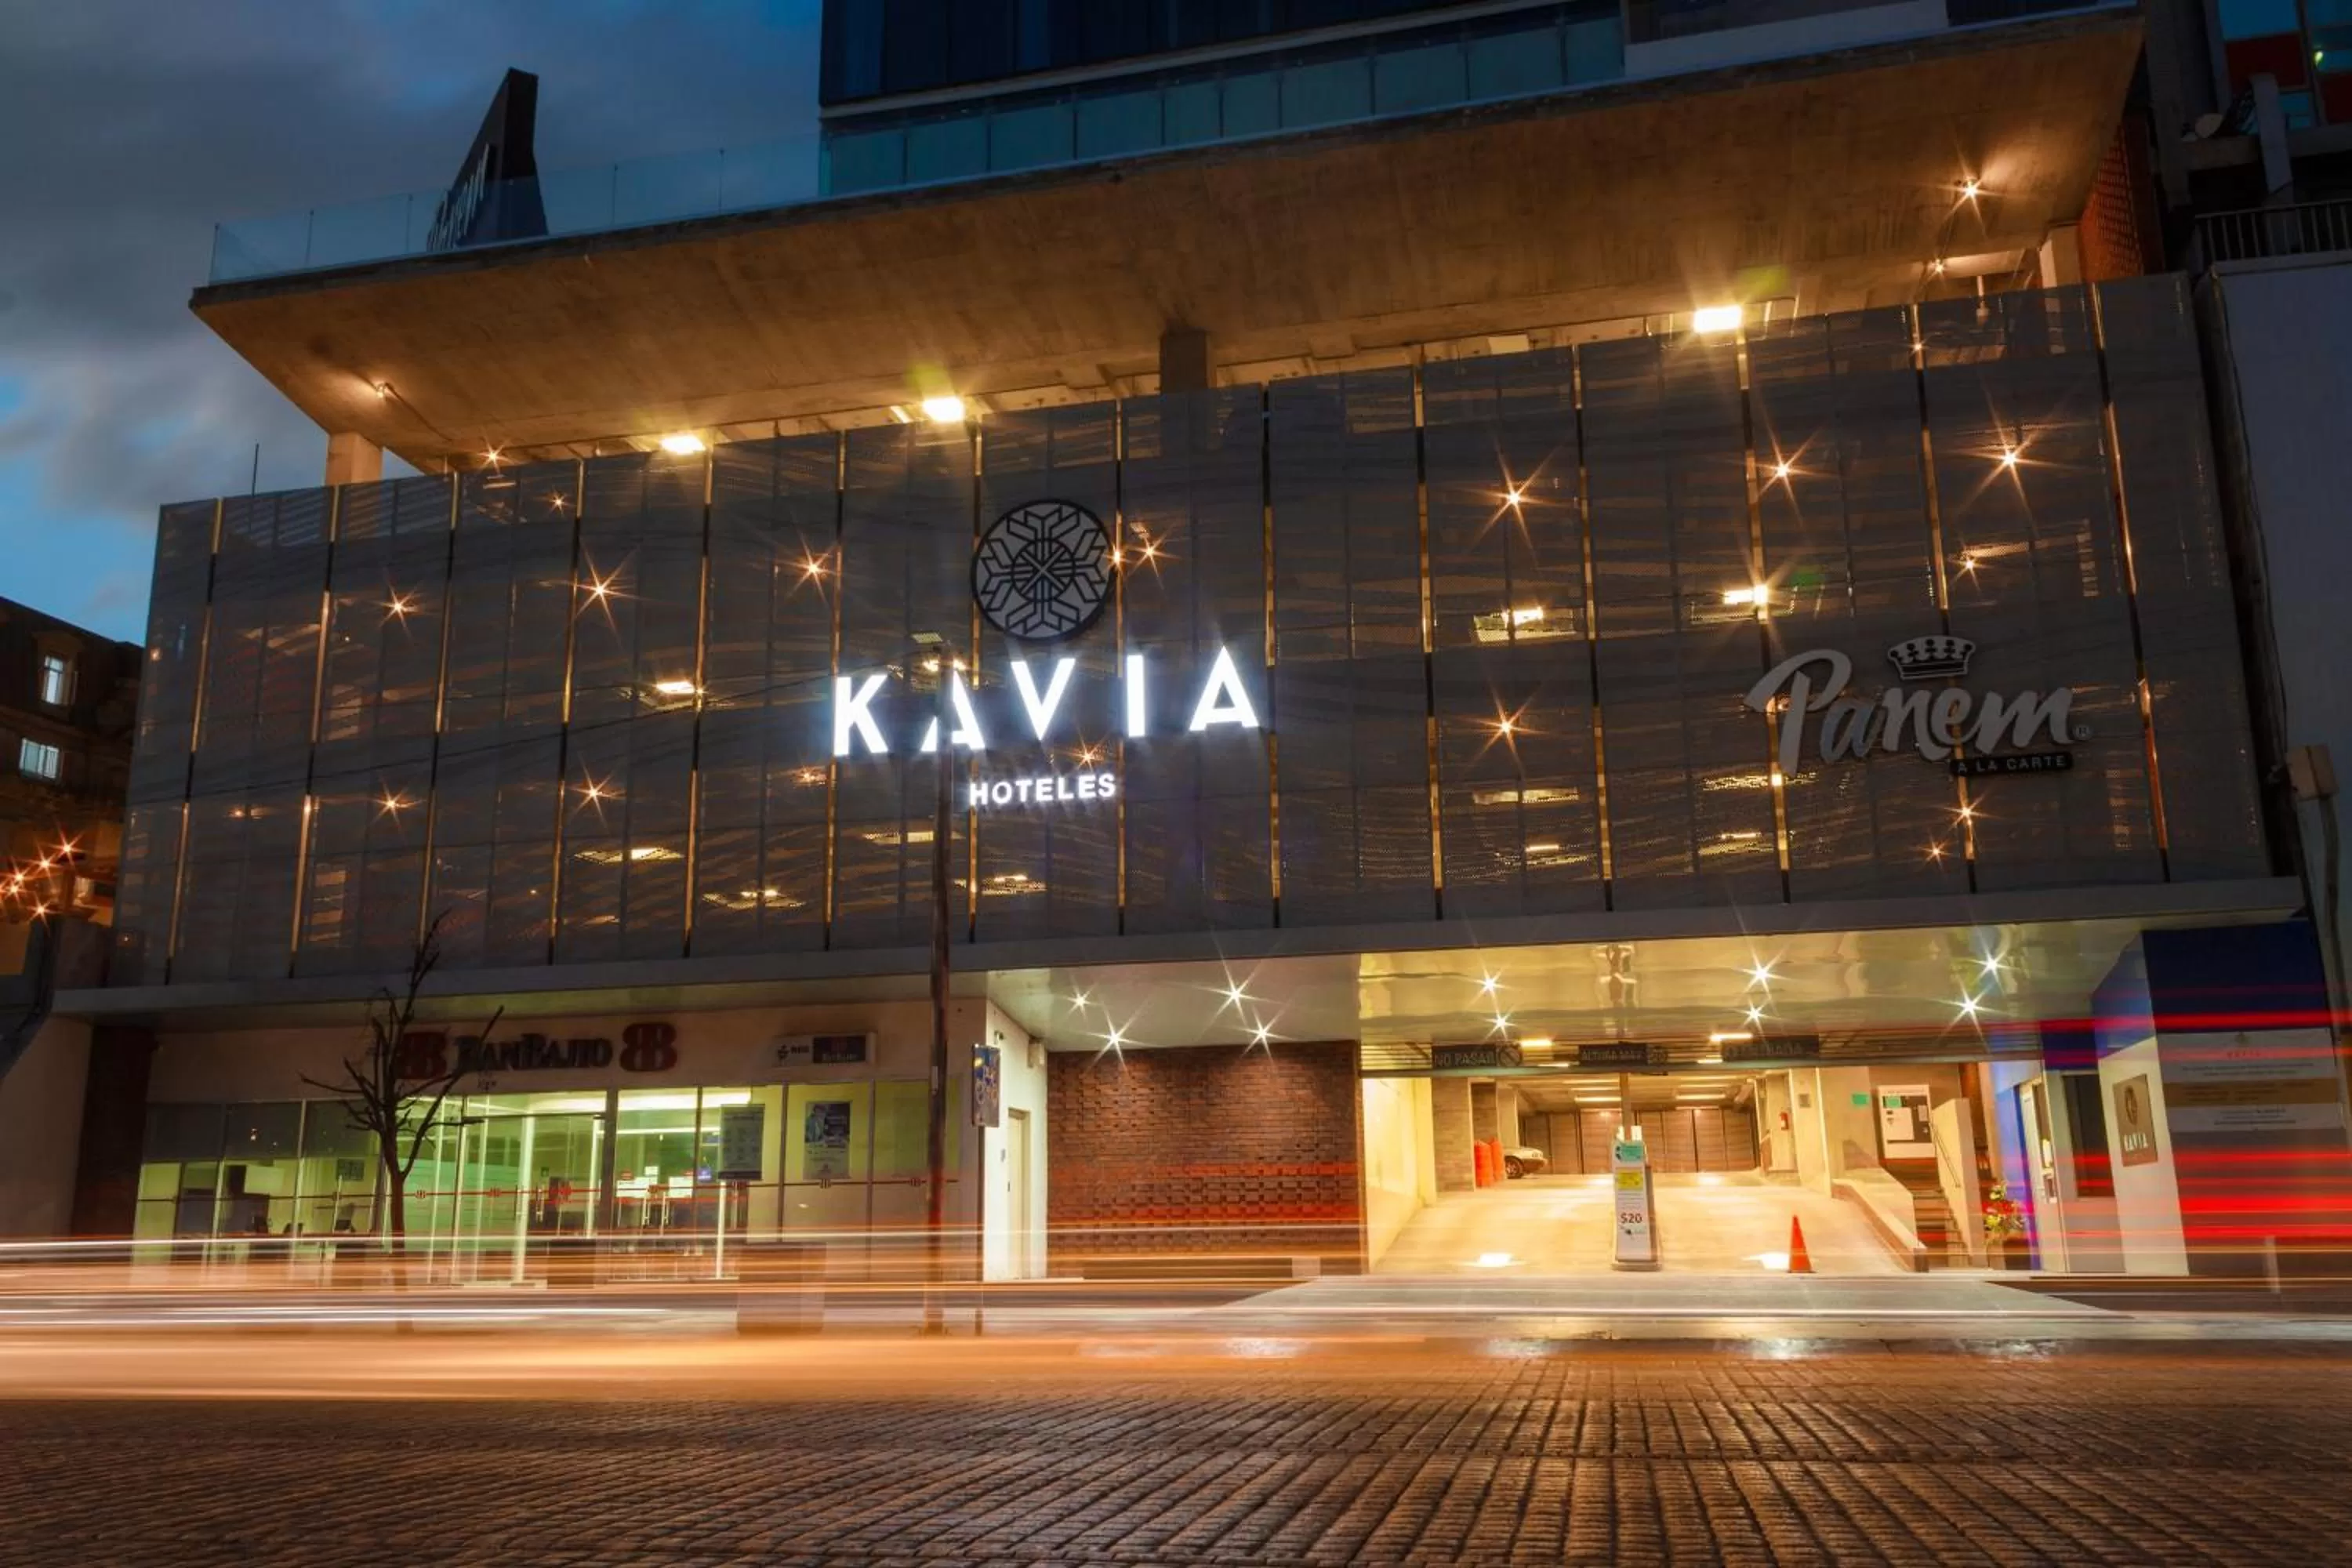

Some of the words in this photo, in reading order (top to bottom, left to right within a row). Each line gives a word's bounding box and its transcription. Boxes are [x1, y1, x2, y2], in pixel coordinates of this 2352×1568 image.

[833, 644, 1261, 757] KAVIA
[1744, 648, 2075, 776] Panem
[1975, 759, 1998, 772] LA
[2006, 755, 2066, 771] CARTE
[969, 772, 1116, 807] HOTELES
[1434, 1052, 1452, 1067] NO
